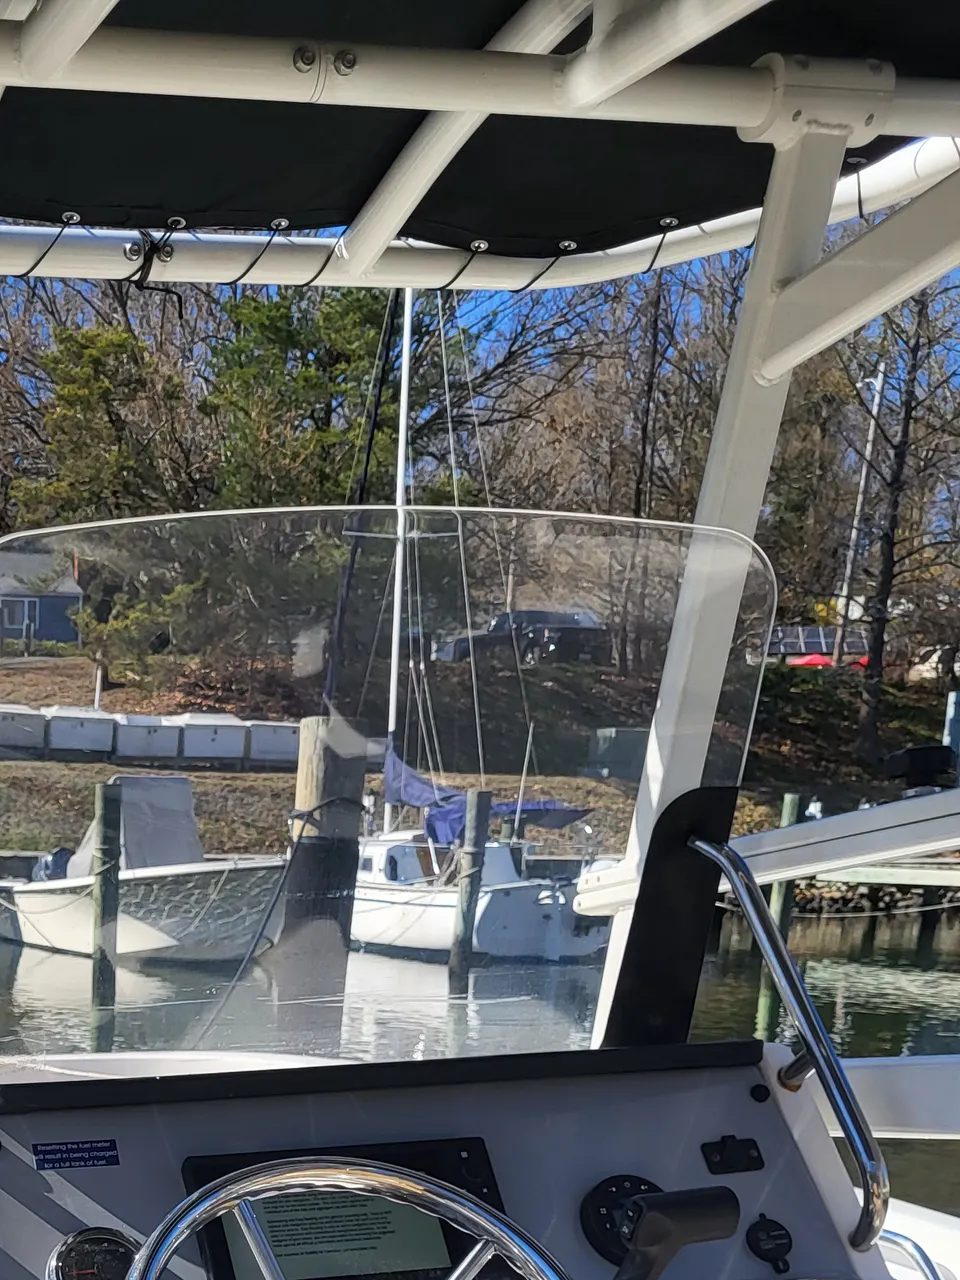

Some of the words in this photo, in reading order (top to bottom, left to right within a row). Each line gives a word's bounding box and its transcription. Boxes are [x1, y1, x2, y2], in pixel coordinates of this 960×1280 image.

[38, 1143, 66, 1151] Resetting
[70, 1151, 89, 1159] being
[89, 1150, 117, 1158] charged
